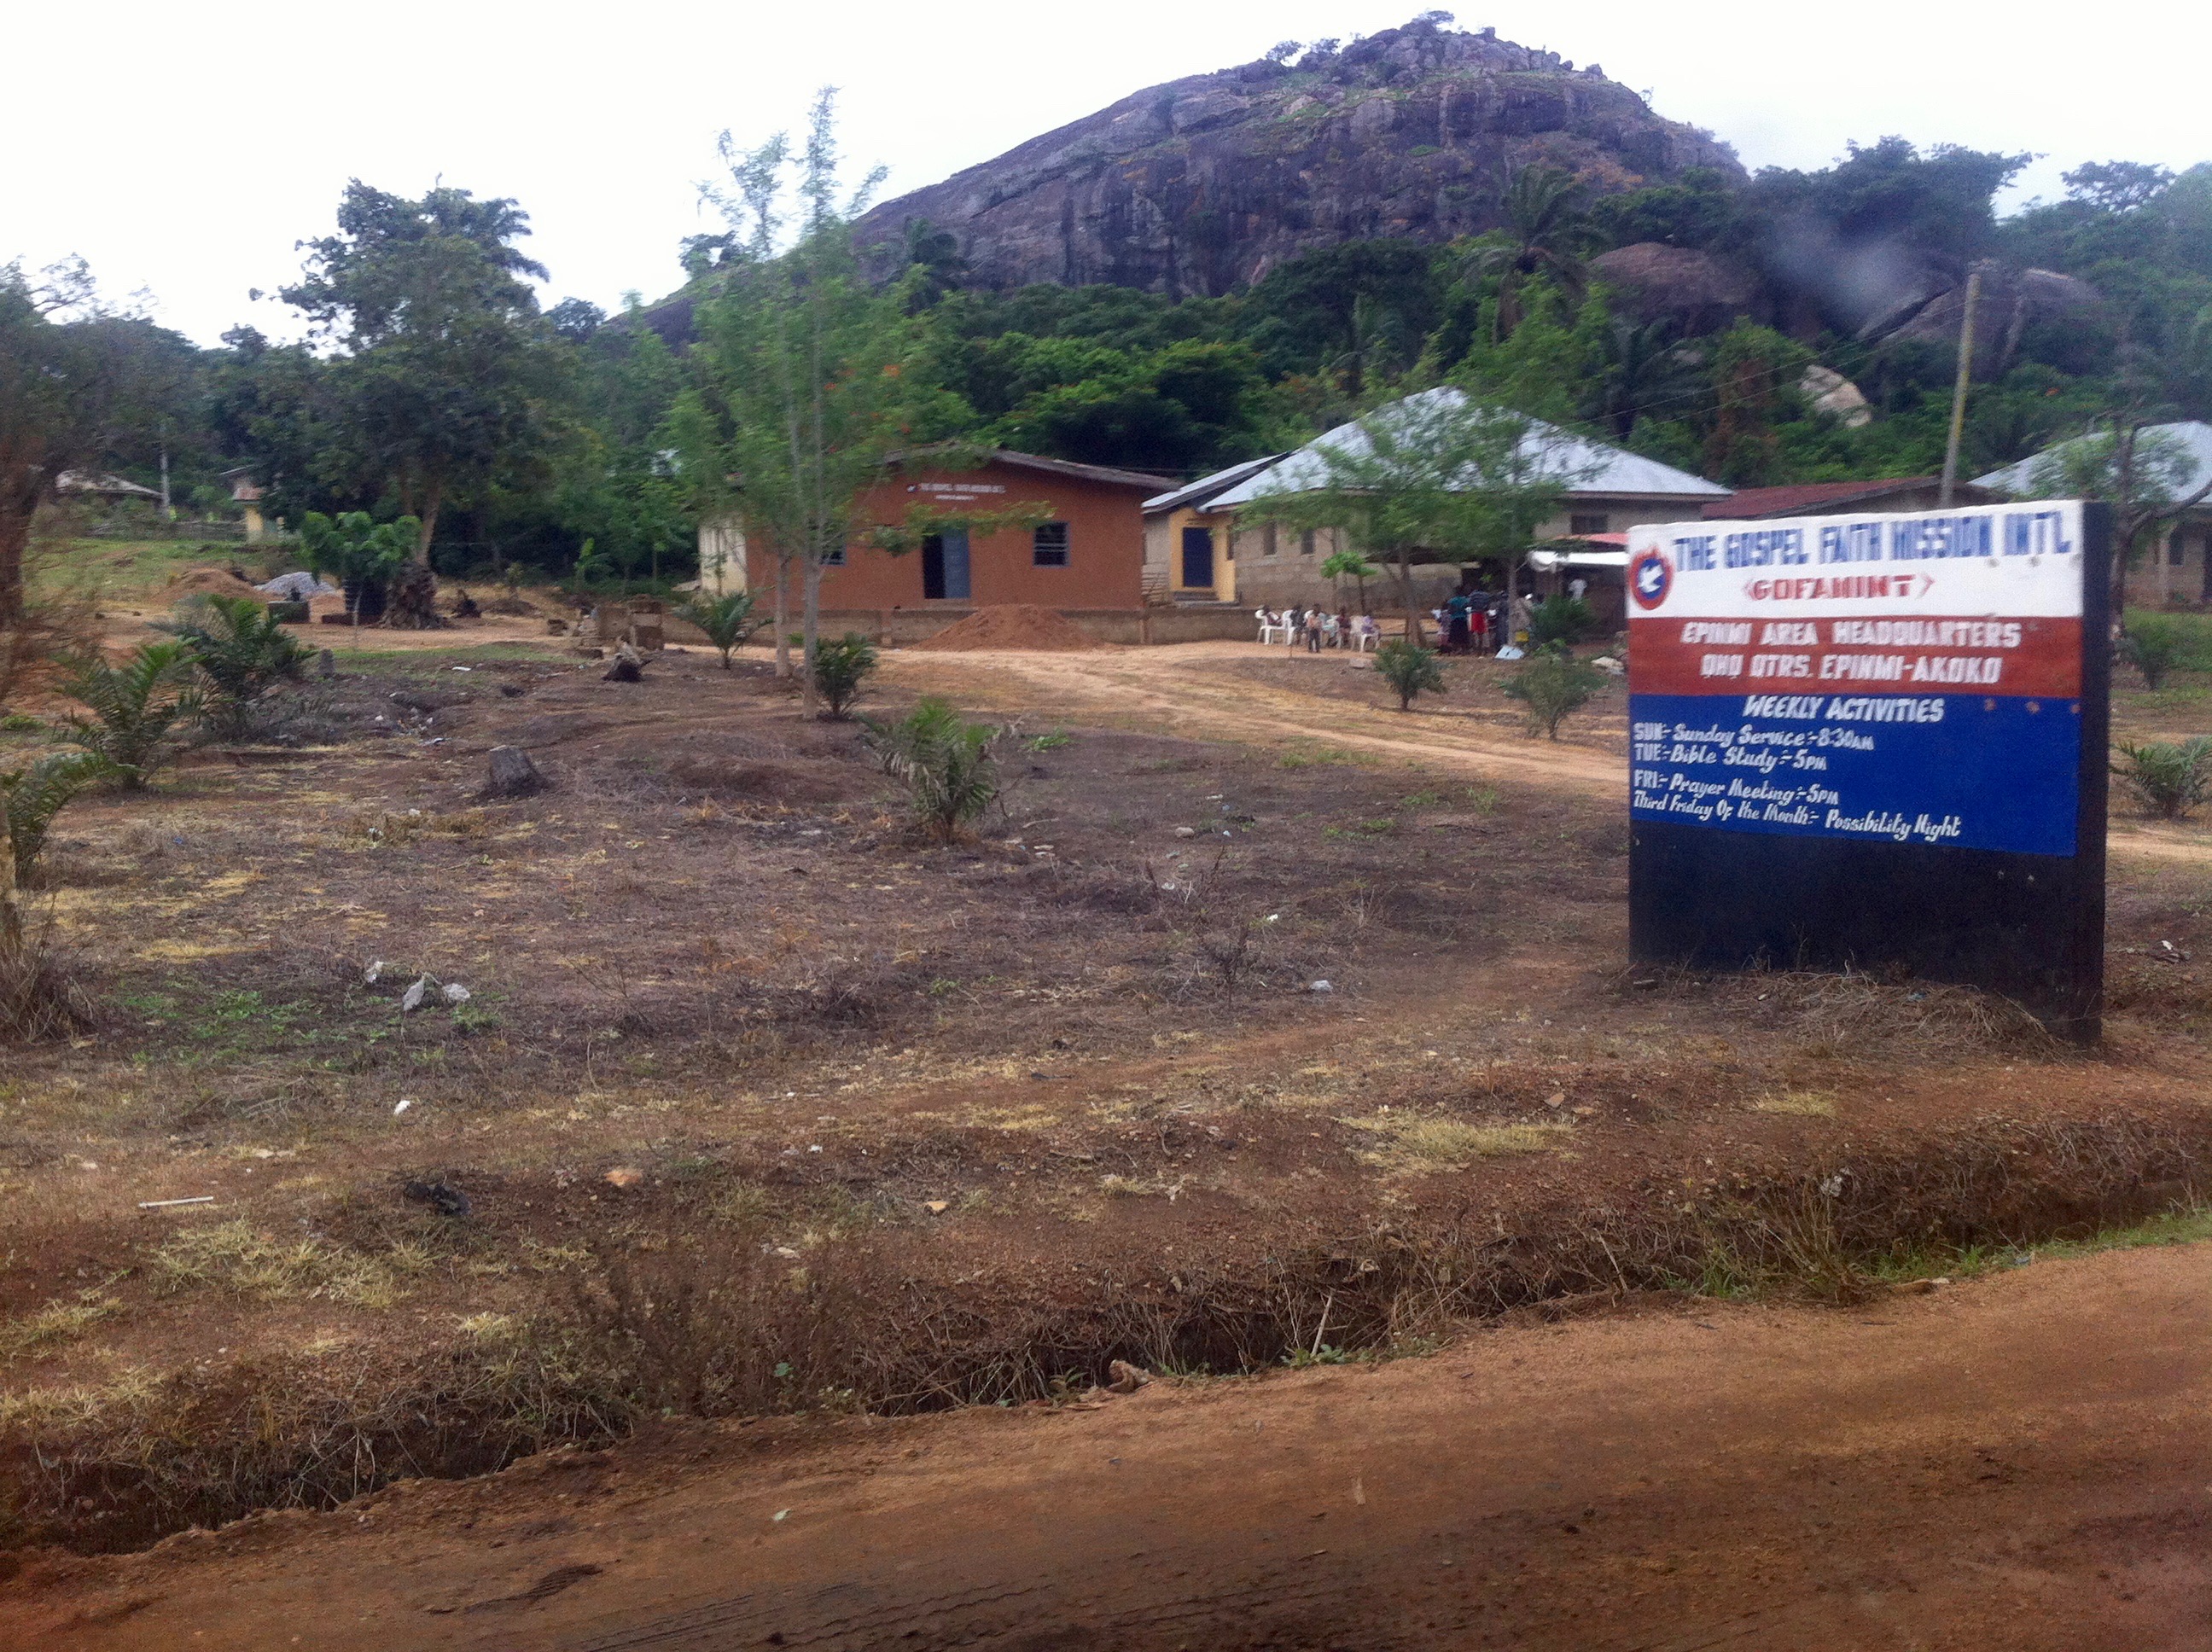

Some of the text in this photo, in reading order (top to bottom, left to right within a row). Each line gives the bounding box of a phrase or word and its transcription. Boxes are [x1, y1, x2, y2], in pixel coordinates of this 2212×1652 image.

[1674, 534, 1719, 571] THE
[1760, 622, 1819, 646] AREA
[1831, 620, 2023, 649] HEADQUARTERS
[1742, 695, 1945, 723] WEEKLY ACTIVITIES
[1672, 723, 1736, 747] Sunday
[1669, 743, 1717, 765] Bible
[1668, 772, 1726, 799] Prayer
[1633, 789, 1669, 811] Third
[1668, 794, 1714, 822] Friday
[1824, 808, 1912, 841] Possibility
[1912, 812, 1962, 843] Night
